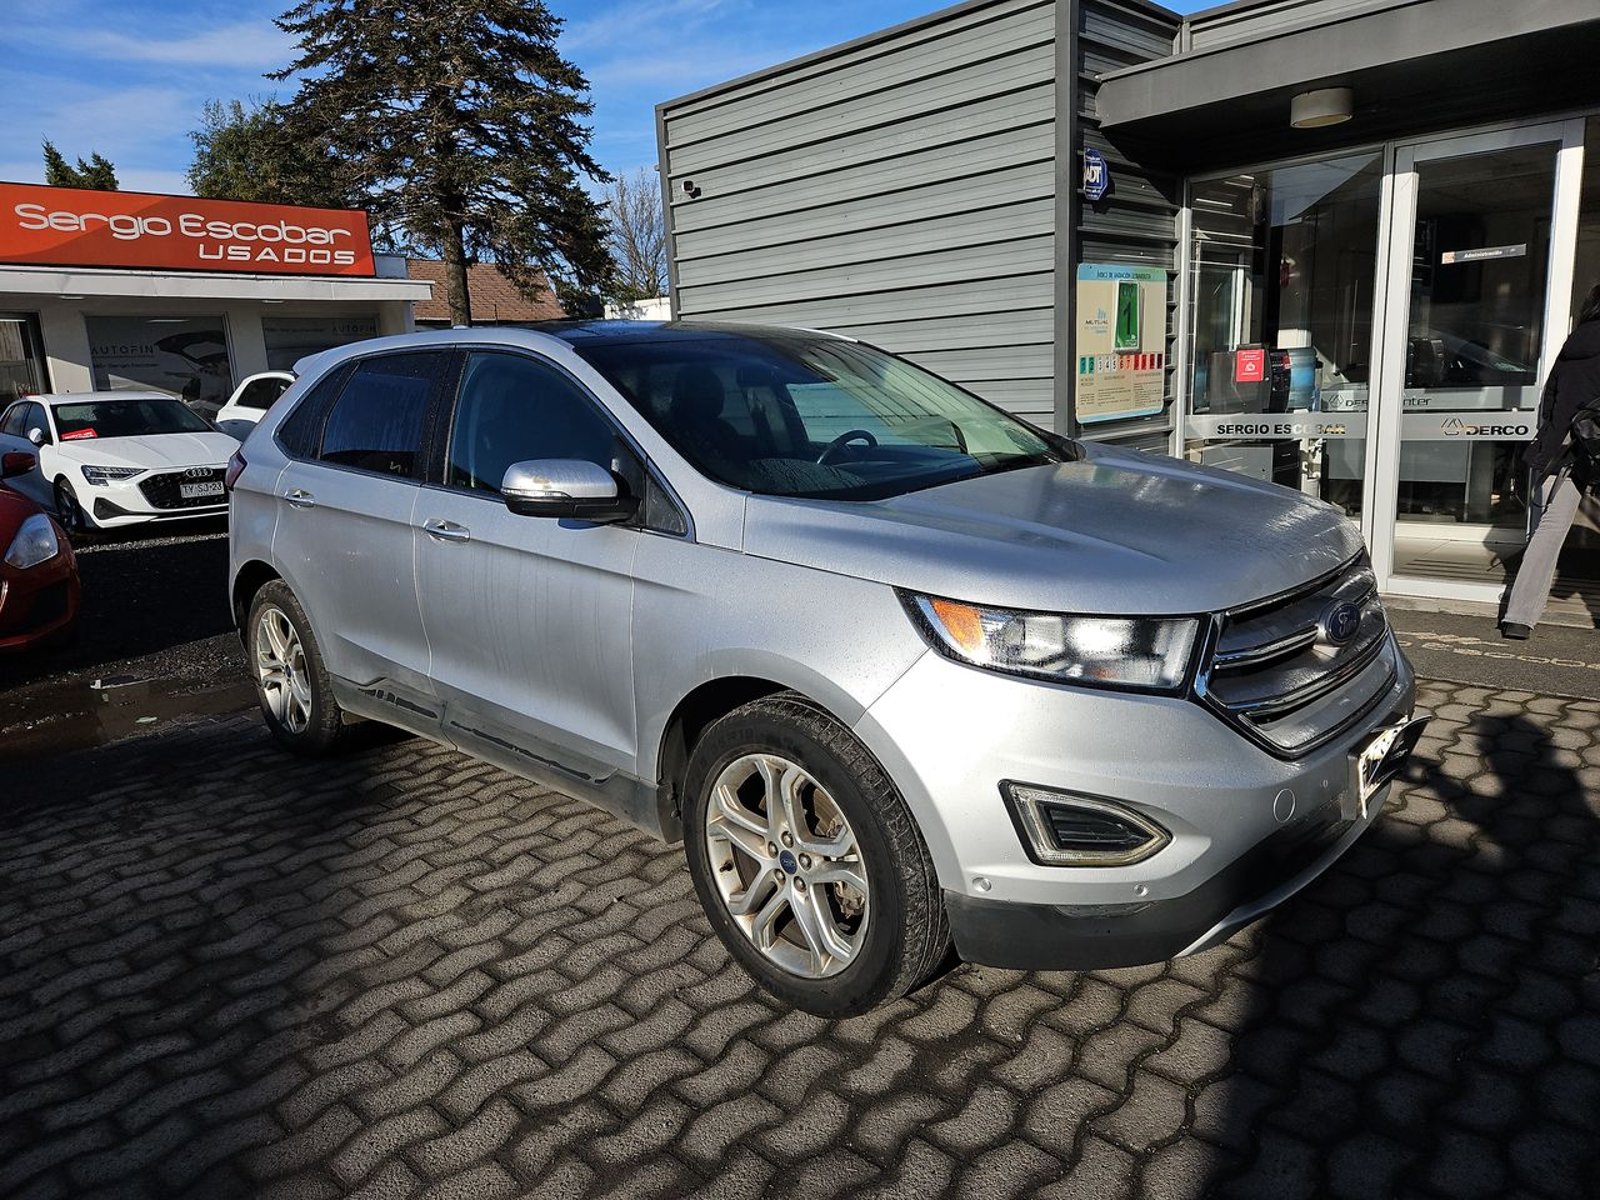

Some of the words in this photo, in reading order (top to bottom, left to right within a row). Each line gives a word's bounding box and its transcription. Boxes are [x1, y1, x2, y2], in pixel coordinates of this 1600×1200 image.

[14, 203, 172, 241] Sergio
[178, 213, 352, 245] Escobar
[199, 243, 355, 265] USADOS
[91, 344, 154, 355] AUTOFIN
[1217, 424, 1270, 435] SERGIO
[1466, 425, 1529, 436] DERCO
